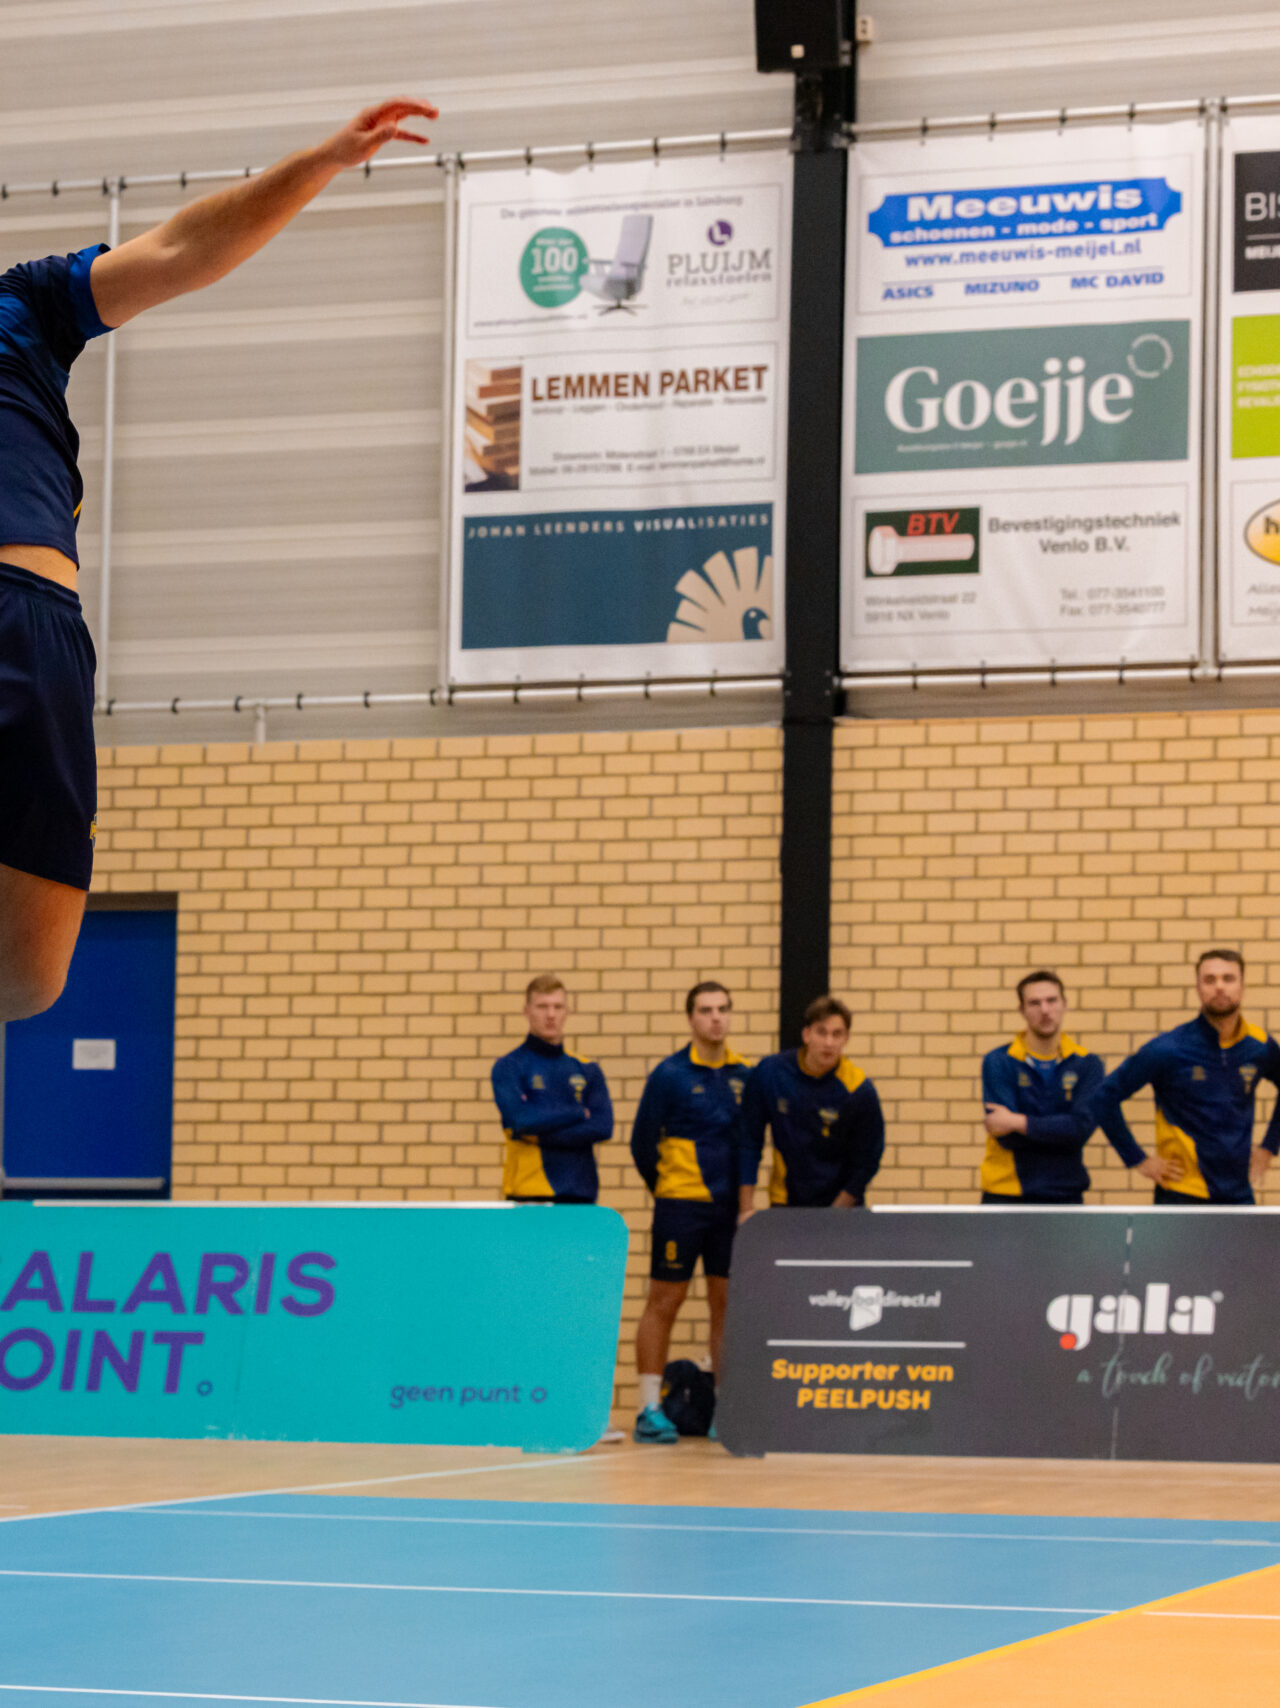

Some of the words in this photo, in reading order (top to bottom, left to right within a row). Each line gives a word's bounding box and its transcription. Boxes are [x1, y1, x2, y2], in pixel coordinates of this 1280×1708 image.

[906, 184, 1143, 222] Meeuwis
[1245, 192, 1280, 221] BI
[889, 224, 995, 245] schoenen
[1016, 214, 1078, 237] mode
[1099, 212, 1158, 235] sport
[530, 246, 579, 275] 100
[667, 248, 772, 276] PLUIJM
[904, 238, 1142, 268] www.meeuwis-meijel.nl
[881, 285, 934, 301] ASICS
[964, 279, 1040, 297] MIZUNO
[1070, 275, 1099, 290] MC
[1106, 271, 1165, 288] DAVID
[531, 372, 650, 401] LEMMEN
[659, 365, 770, 396] PARKET
[884, 356, 1135, 446] Goejje
[469, 524, 526, 539] JOHAN
[534, 520, 625, 536] LEENDERS
[633, 513, 770, 533] VISUALISATIES
[906, 512, 960, 537] BTV
[987, 511, 1182, 535] Bevestigingstechniek
[1039, 537, 1089, 555] Venlo
[1094, 535, 1130, 553] B.V.
[1046, 1282, 1217, 1352] gala
[771, 1358, 901, 1385] Supporter
[905, 1364, 955, 1382] van
[1076, 1368, 1092, 1384] a
[1101, 1351, 1174, 1400] touch
[1179, 1353, 1213, 1395] of
[390, 1385, 454, 1410] geen
[459, 1383, 522, 1407] punt
[796, 1387, 932, 1411] PEELPUSH
